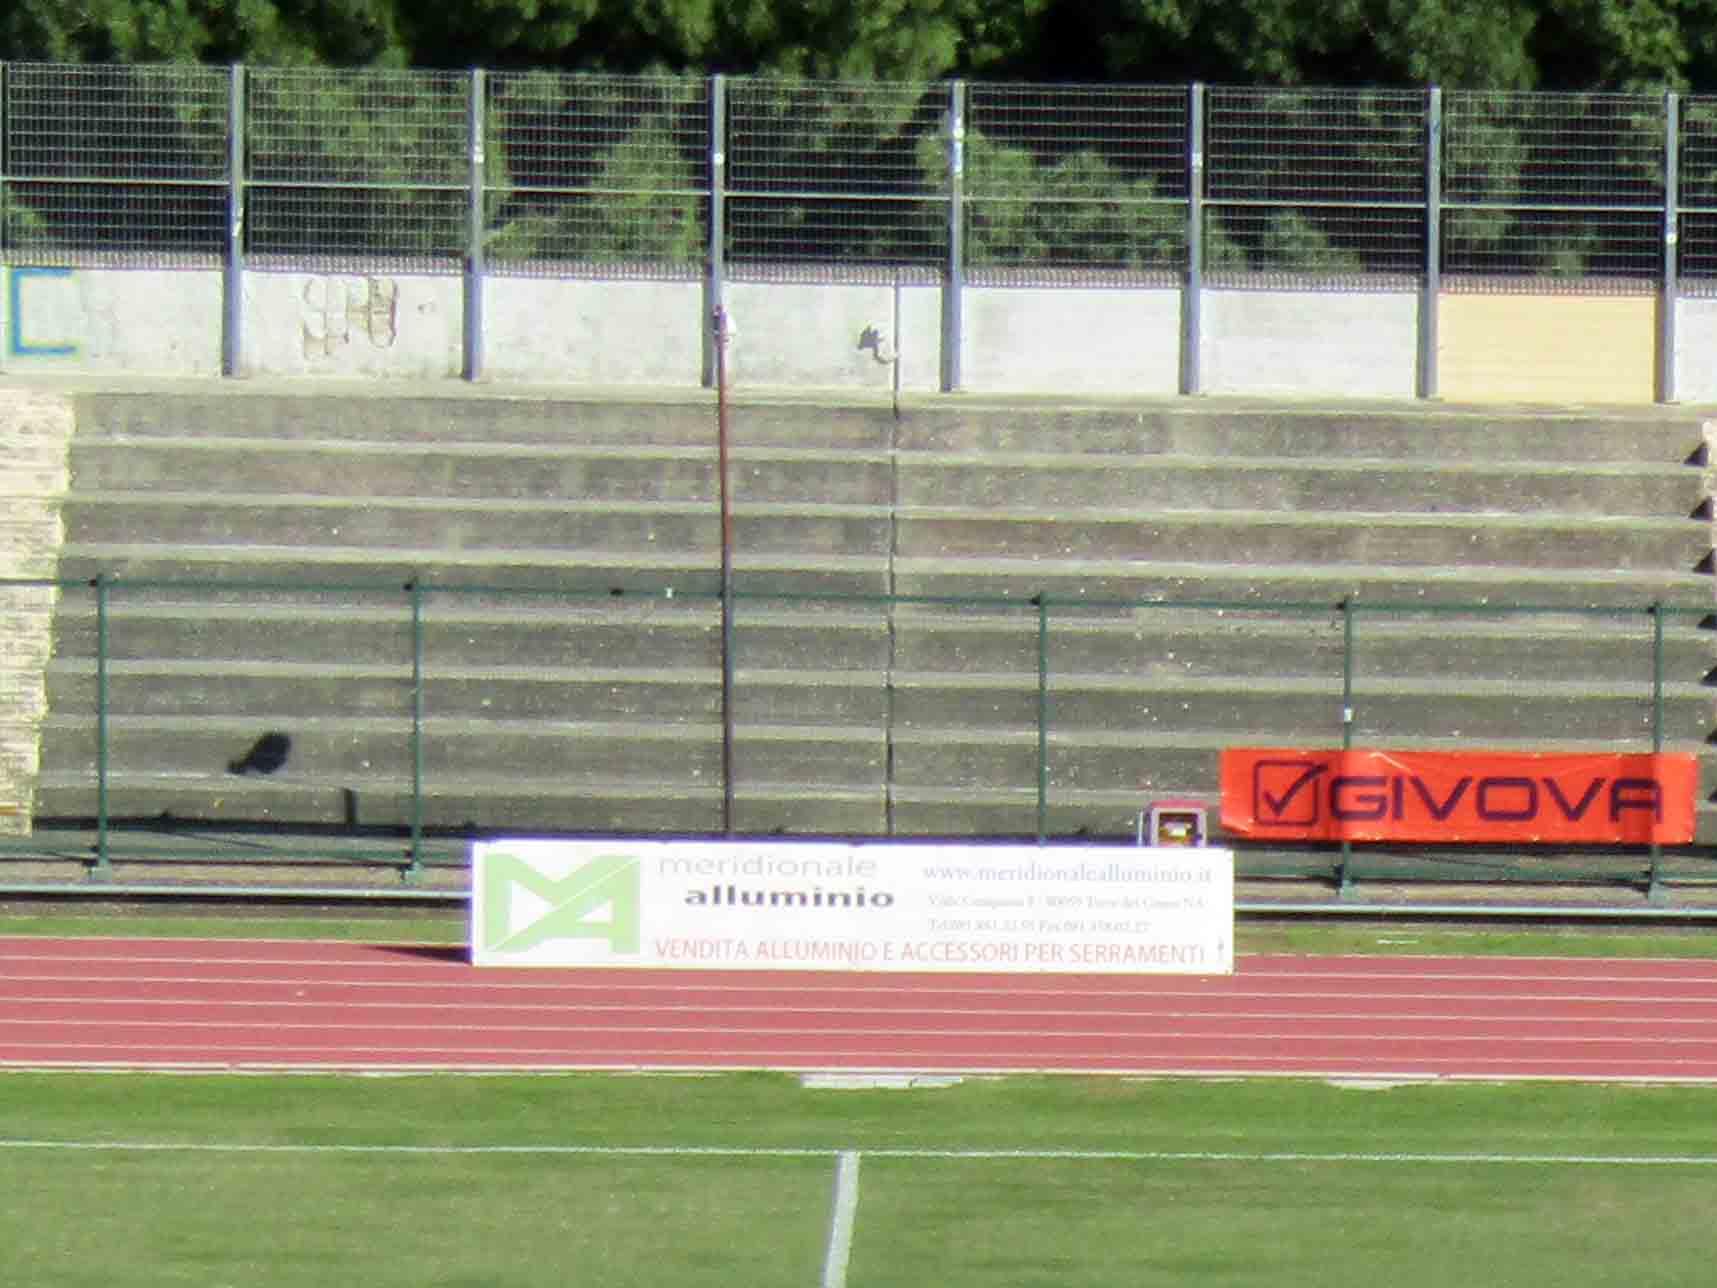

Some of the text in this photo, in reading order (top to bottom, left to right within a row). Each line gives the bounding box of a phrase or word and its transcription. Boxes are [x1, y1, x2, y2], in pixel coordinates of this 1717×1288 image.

[1329, 775, 1662, 824] GIVOVA
[657, 855, 877, 879] meridionale
[684, 883, 895, 909] alluminio
[655, 939, 750, 960] VENDITA
[756, 941, 881, 961] ALLUMINIO
[900, 943, 1018, 961] ACCESSORI
[1025, 944, 1064, 962] PER
[1072, 945, 1206, 964] SERRAMENTI
